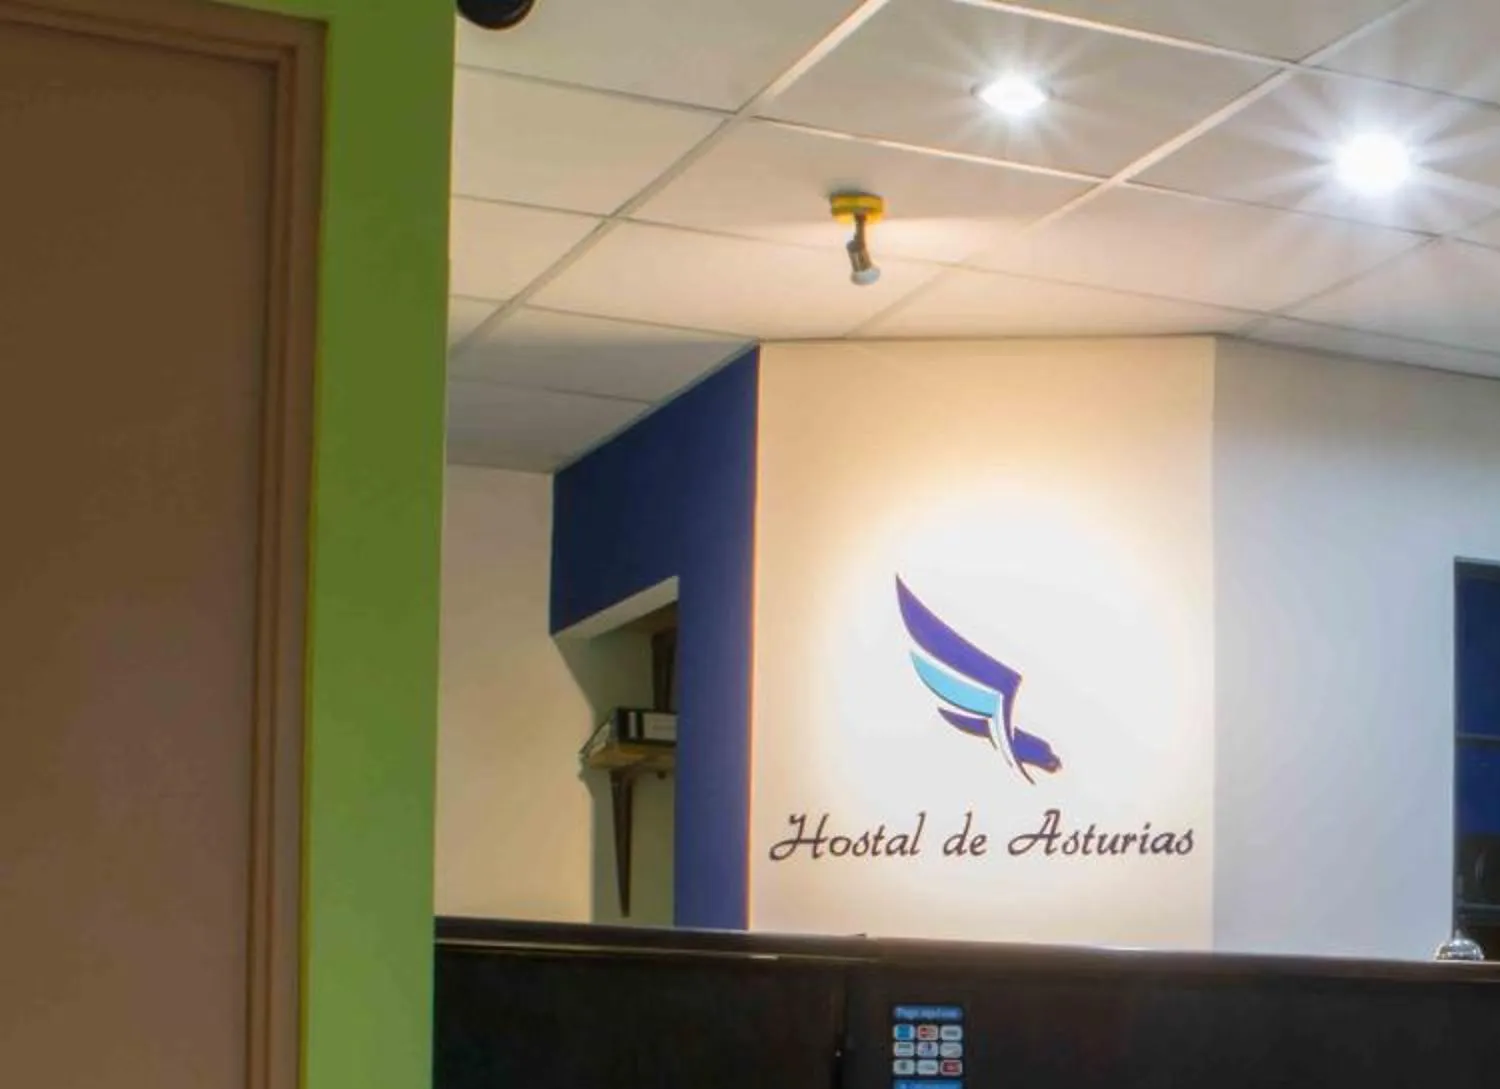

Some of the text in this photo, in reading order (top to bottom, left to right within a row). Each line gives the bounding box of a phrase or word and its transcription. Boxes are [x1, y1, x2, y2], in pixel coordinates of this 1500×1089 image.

[769, 808, 1195, 861] Hostal de Asturias
